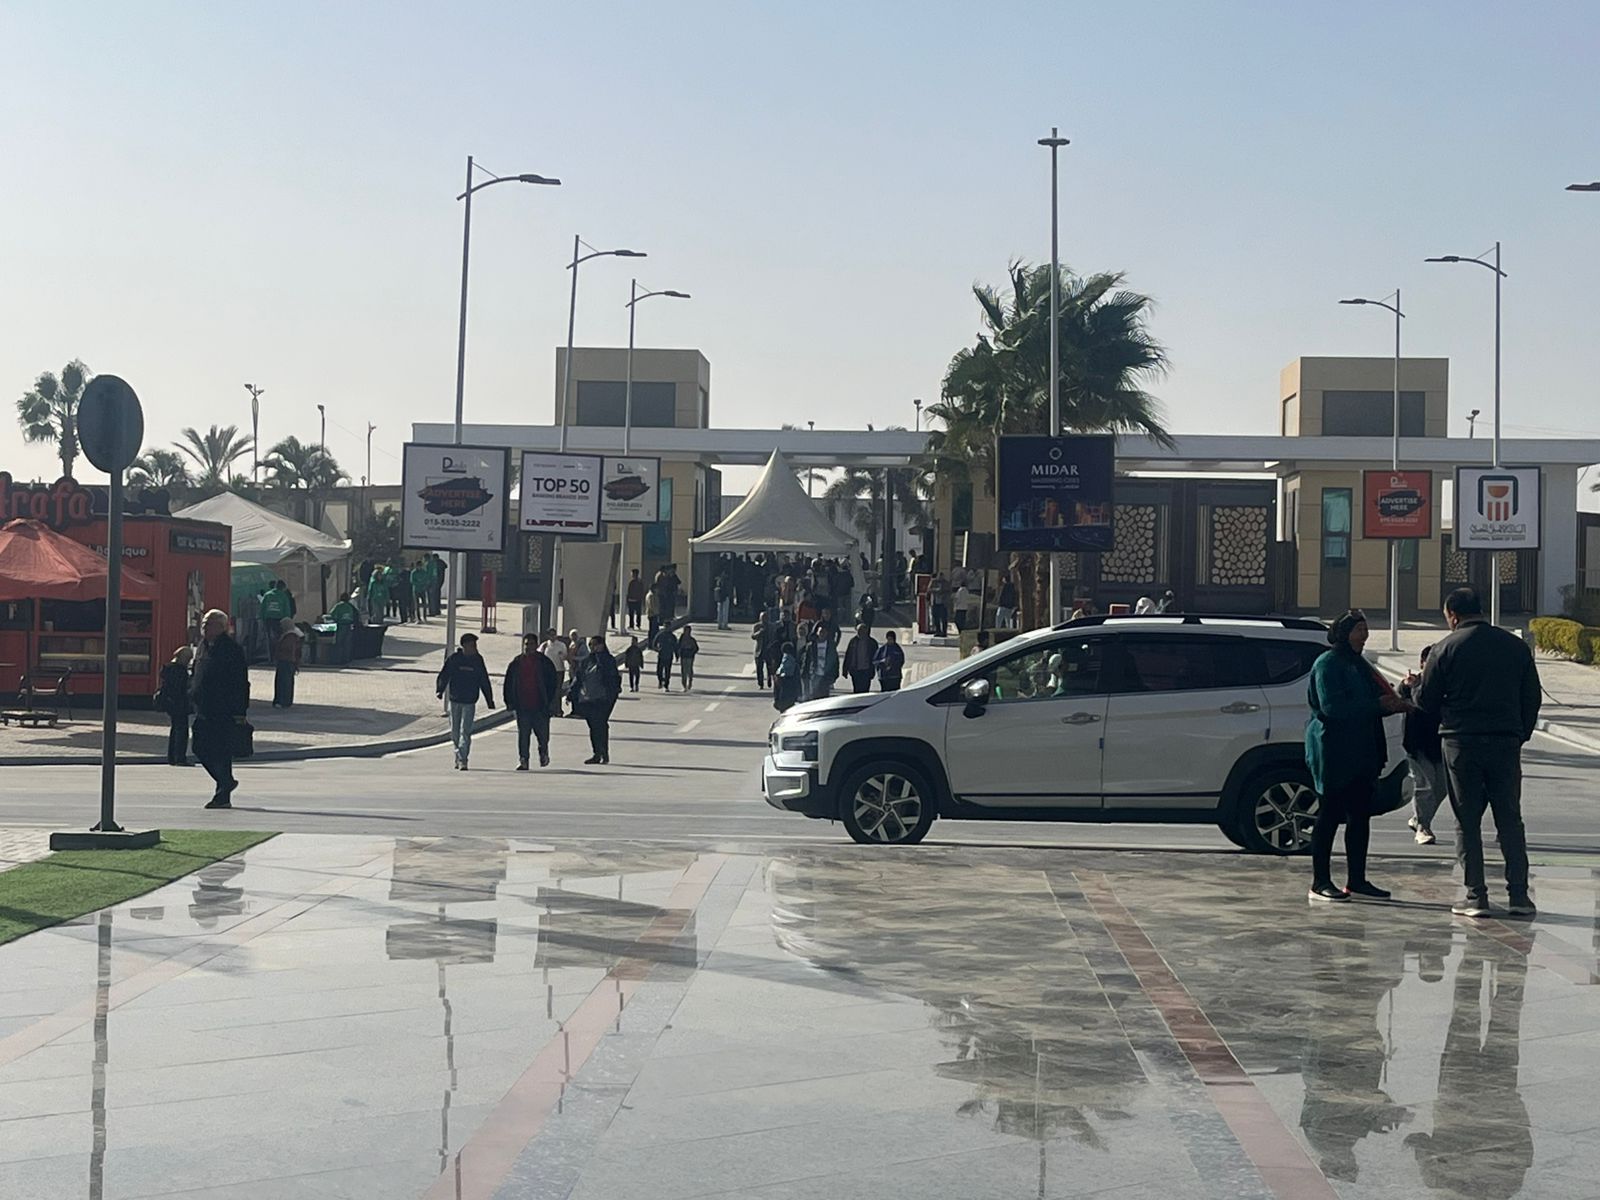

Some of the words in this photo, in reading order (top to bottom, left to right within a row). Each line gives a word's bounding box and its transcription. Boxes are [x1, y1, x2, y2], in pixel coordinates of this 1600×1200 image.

[1031, 464, 1079, 475] MIDAR
[532, 477, 567, 492] TOP
[569, 479, 590, 494] 50
[1381, 497, 1418, 505] ADVERTISE
[96, 544, 147, 558] Boique
